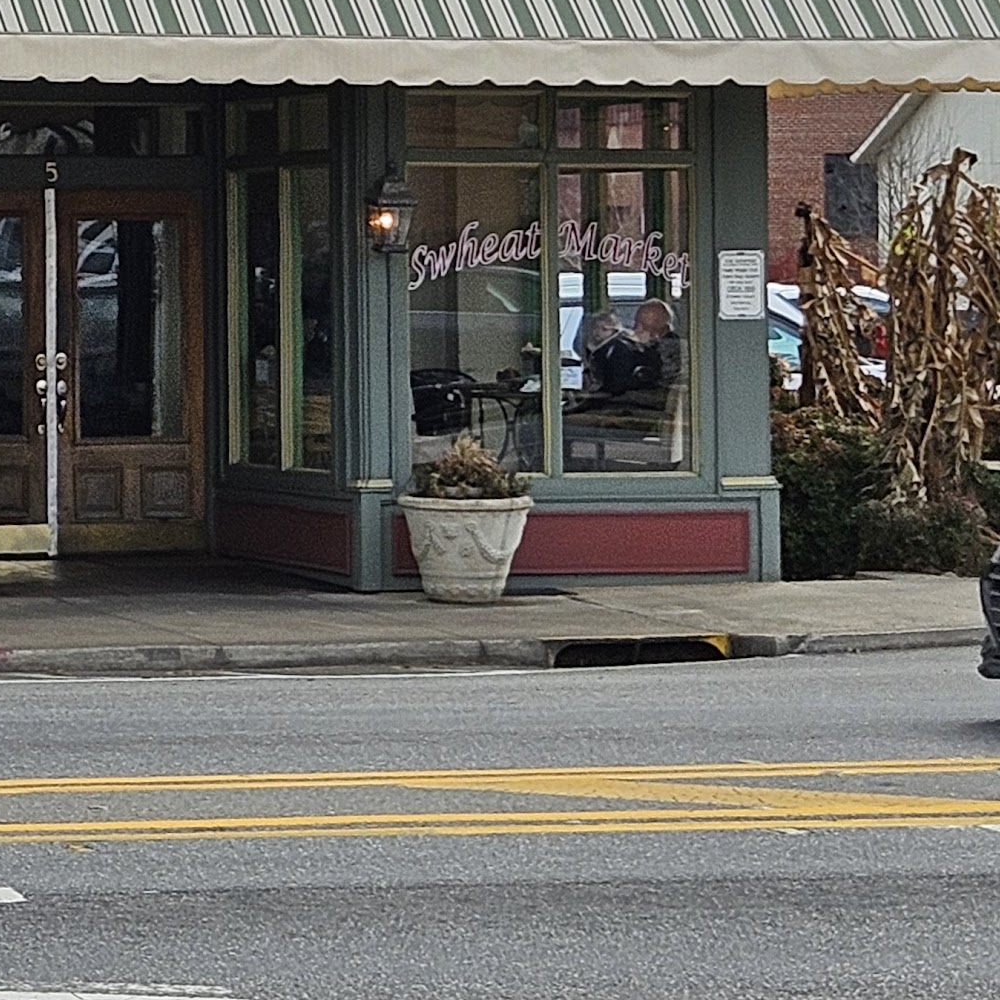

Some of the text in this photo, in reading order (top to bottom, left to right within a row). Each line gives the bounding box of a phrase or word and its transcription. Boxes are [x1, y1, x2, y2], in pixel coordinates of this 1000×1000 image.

[45, 161, 59, 182] 5
[407, 219, 692, 291] Swheat Market
